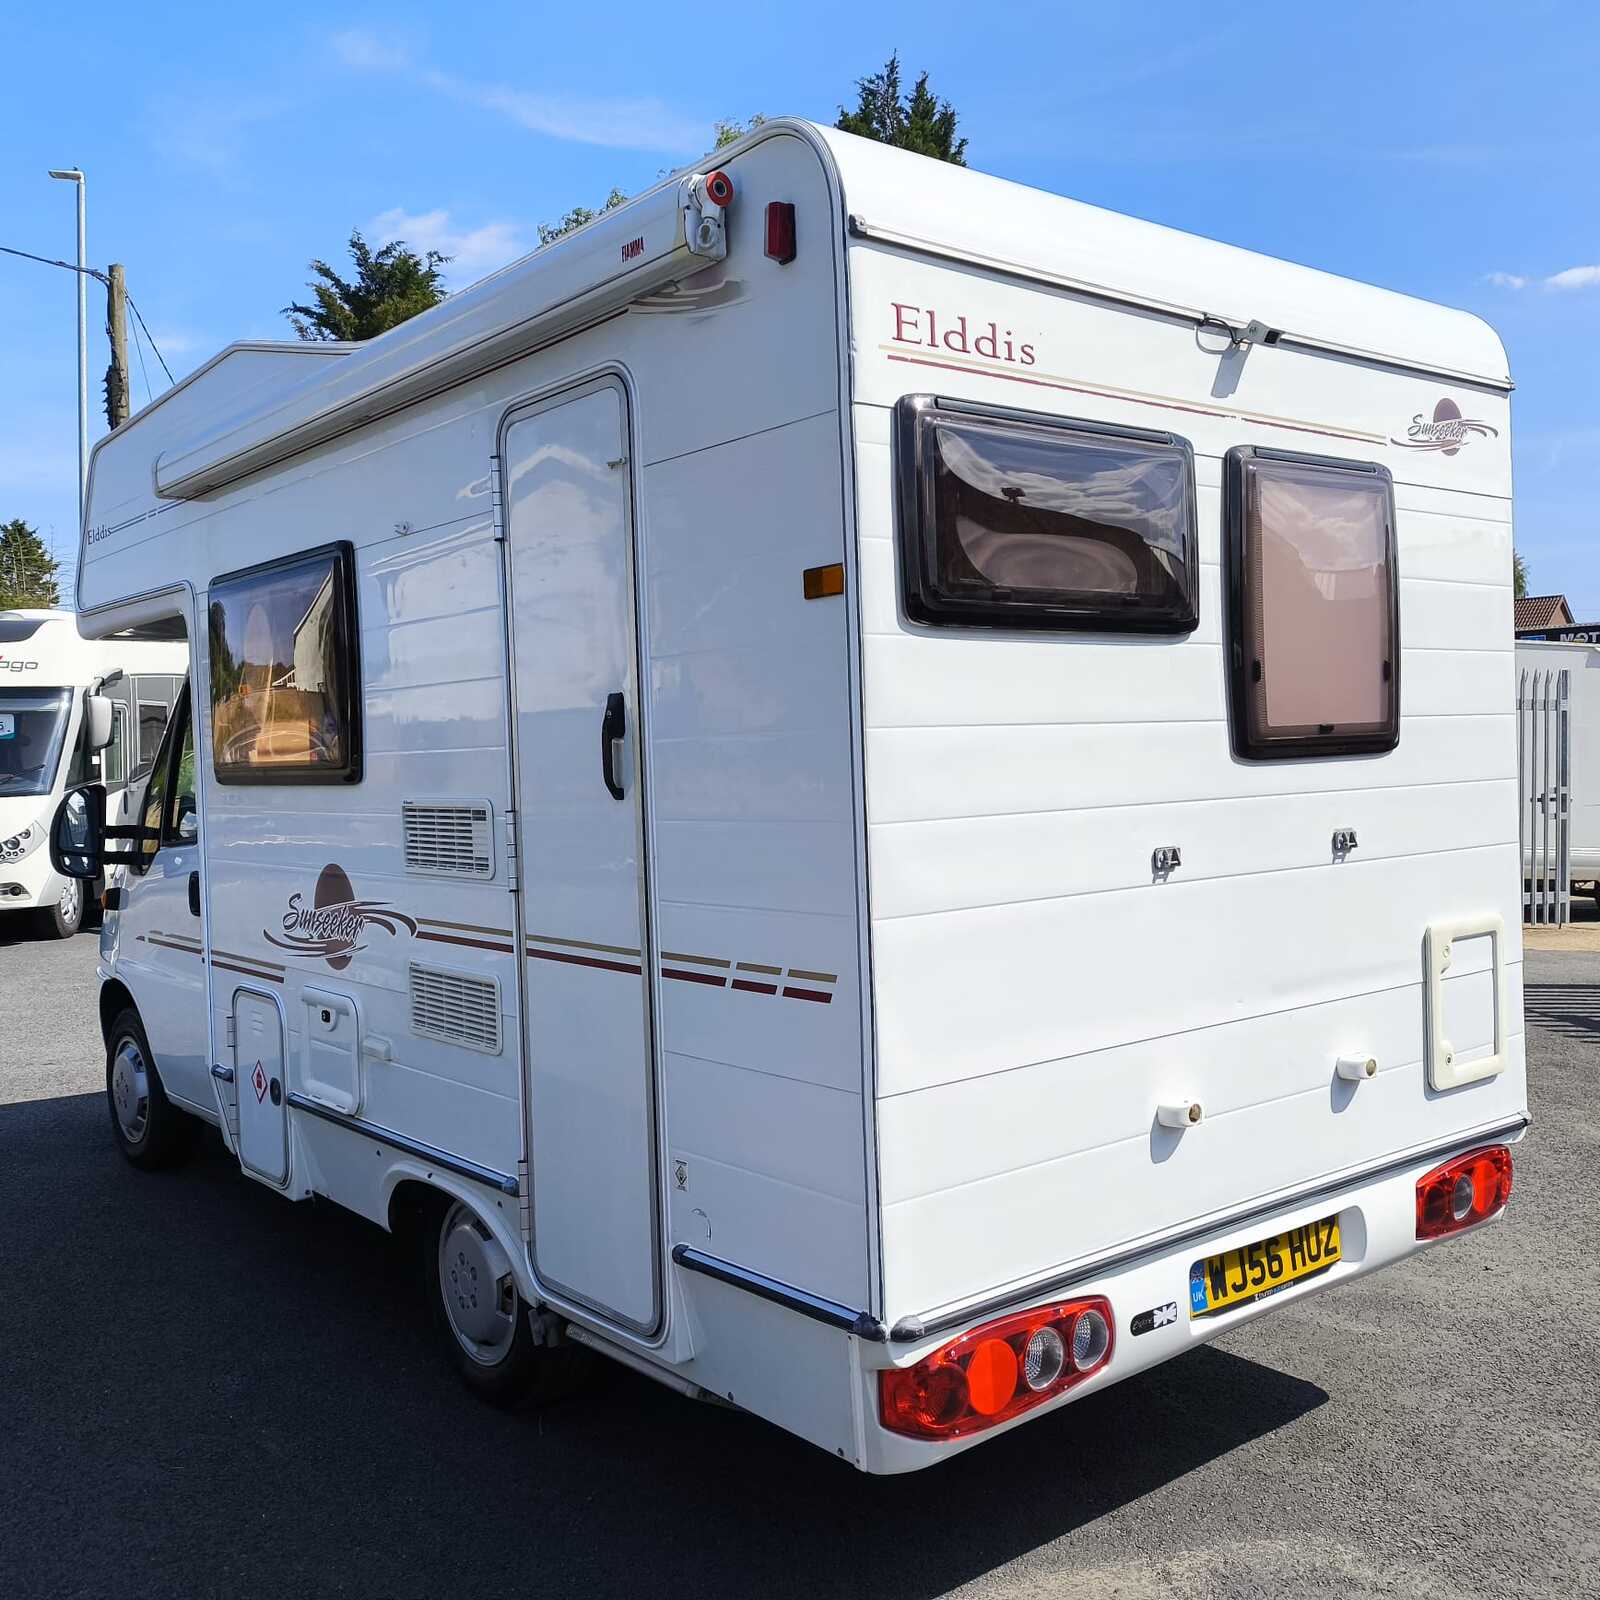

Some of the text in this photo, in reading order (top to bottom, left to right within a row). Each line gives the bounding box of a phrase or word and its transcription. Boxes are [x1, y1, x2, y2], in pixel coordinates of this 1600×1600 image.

[621, 236, 644, 263] FIAMMA
[891, 302, 1036, 366] Elddis
[1407, 413, 1468, 438] Sunseeker
[87, 524, 112, 545] Elddis
[283, 893, 366, 940] Sunseeker
[1208, 1216, 1338, 1300] WJ56 HUZ
[1192, 1288, 1205, 1303] UK
